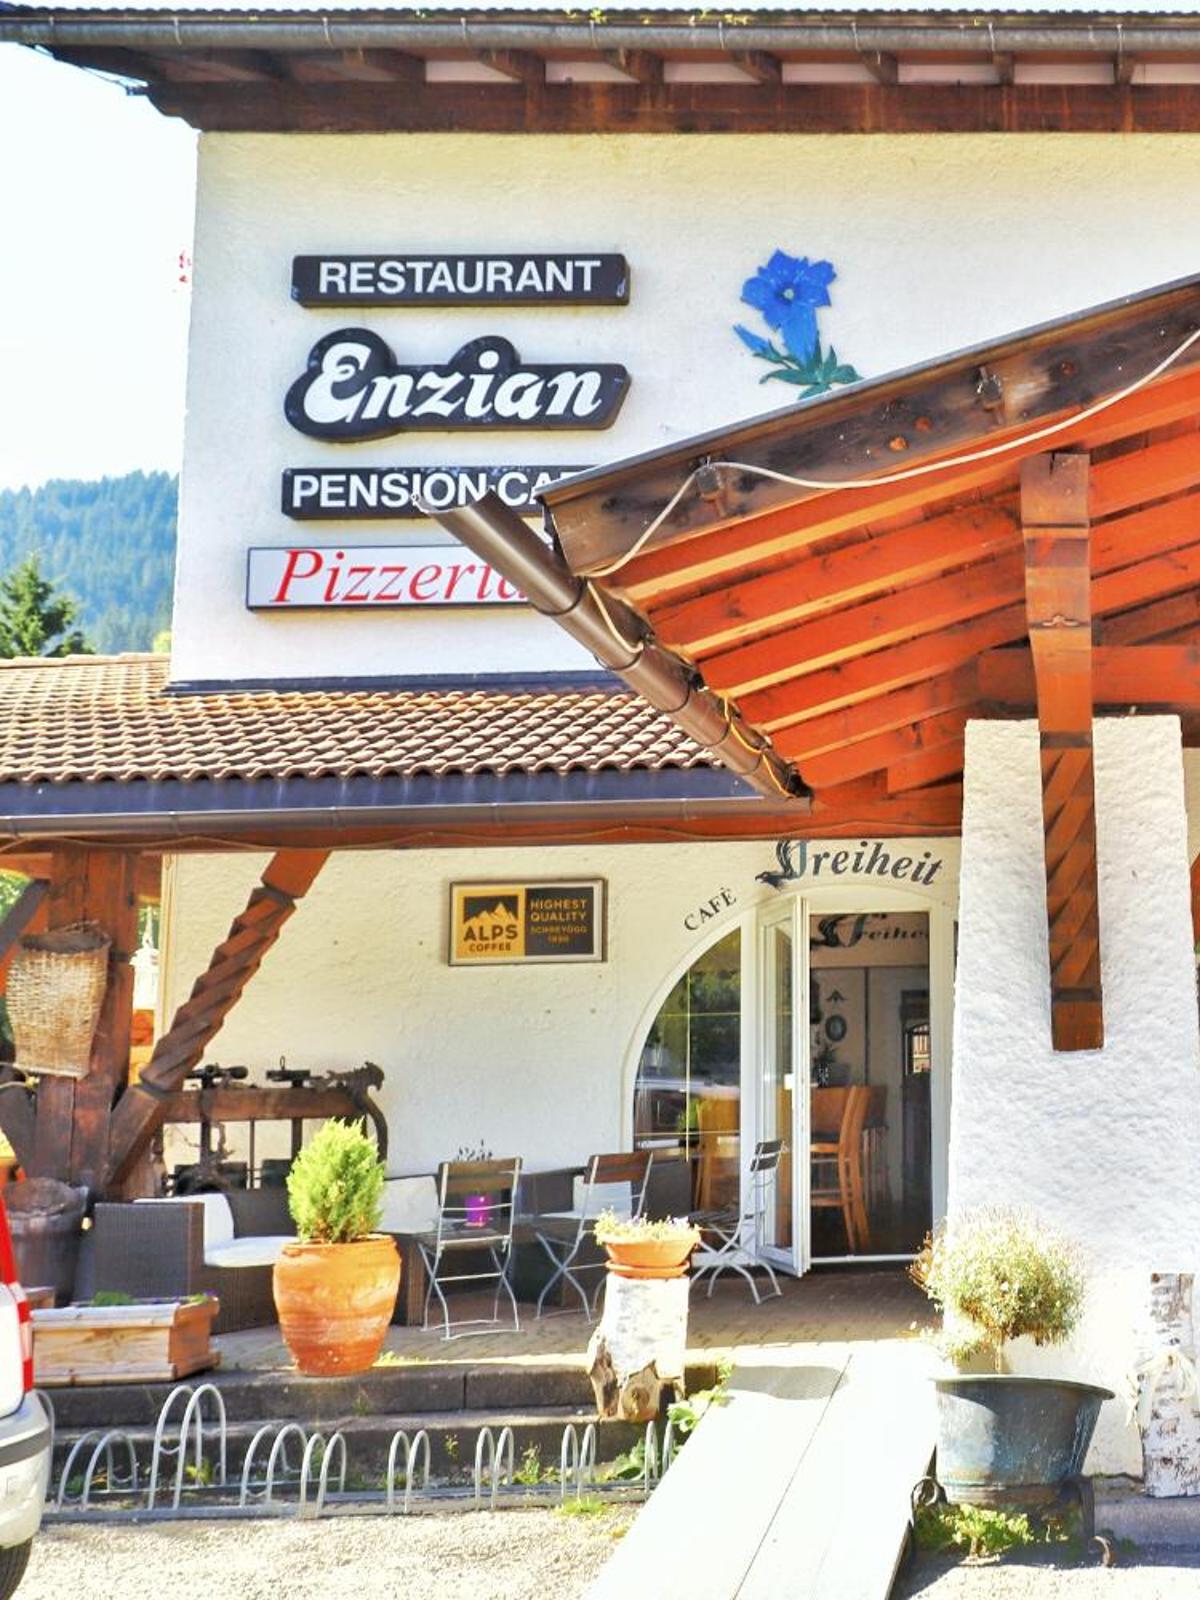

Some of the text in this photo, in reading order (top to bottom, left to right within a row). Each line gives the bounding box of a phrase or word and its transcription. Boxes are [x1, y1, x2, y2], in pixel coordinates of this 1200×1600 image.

[319, 260, 601, 295] RESTAURANT
[303, 341, 603, 424] Enzian
[530, 899, 588, 910] HIGHEST
[530, 911, 587, 923] QUALITY
[463, 924, 519, 942] ALPS
[468, 942, 512, 953] COFFEE
